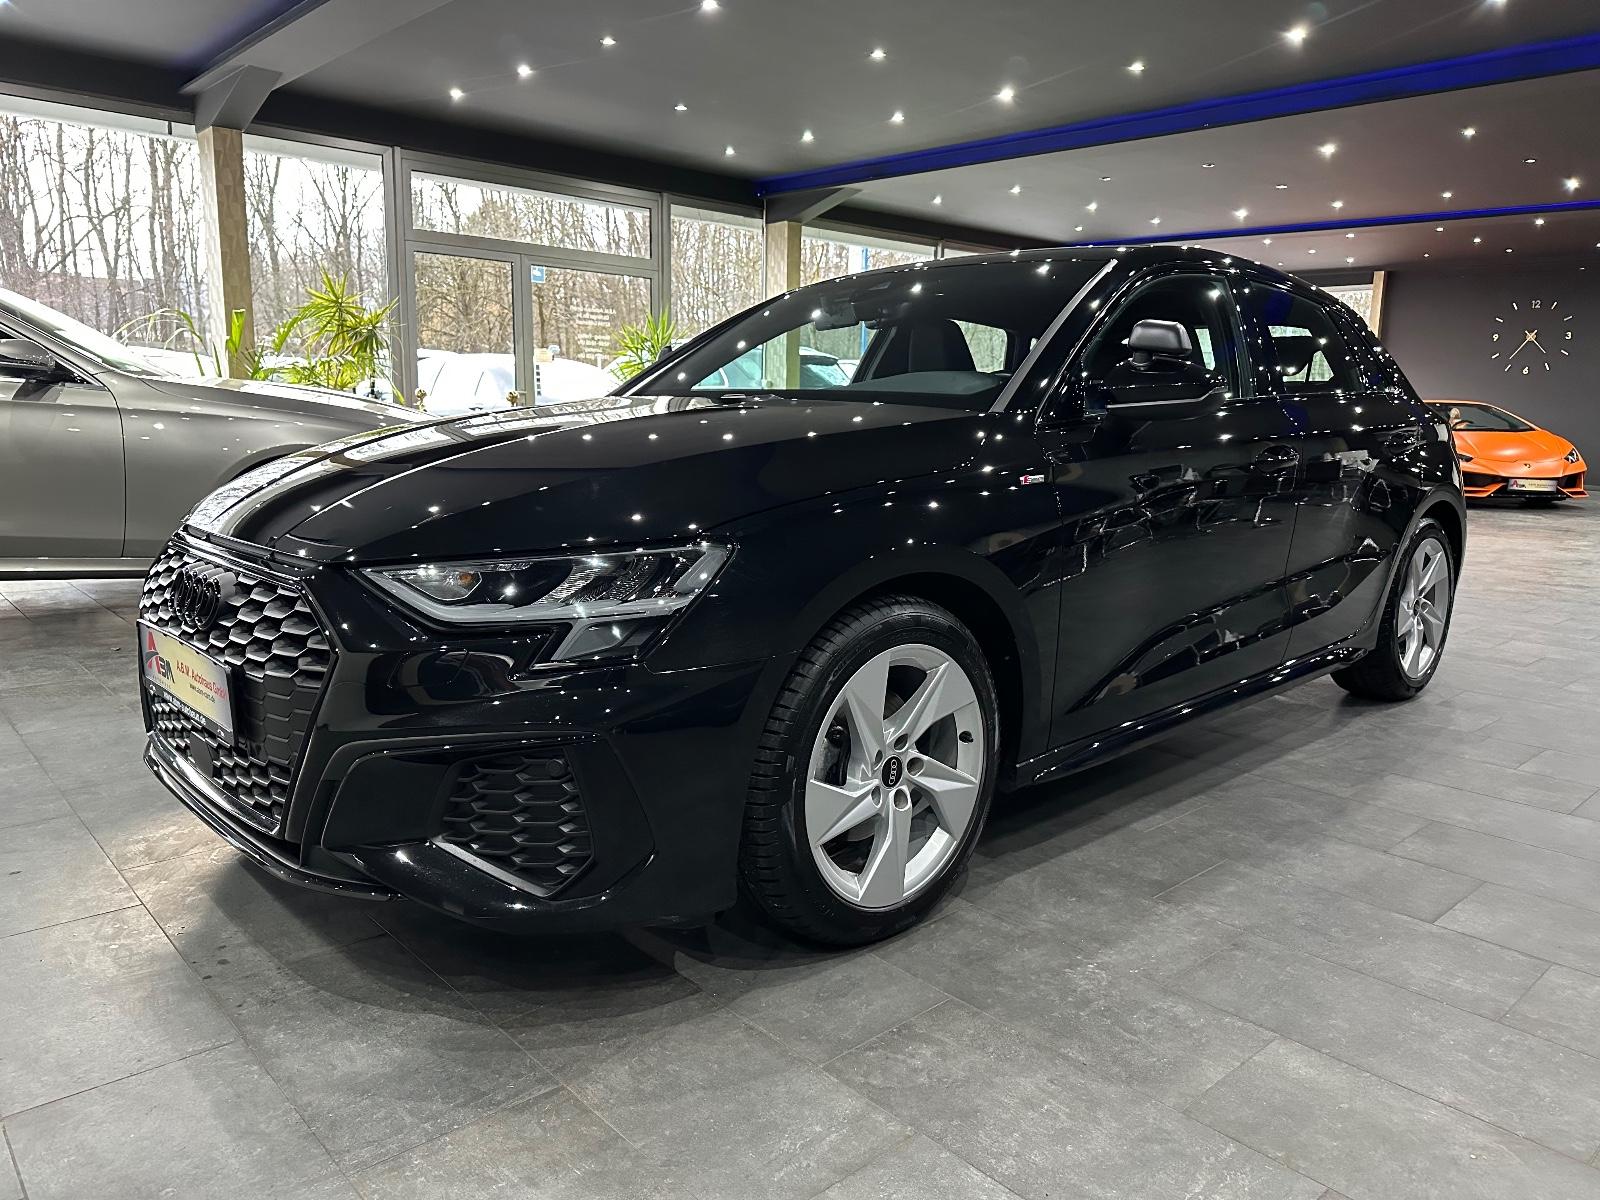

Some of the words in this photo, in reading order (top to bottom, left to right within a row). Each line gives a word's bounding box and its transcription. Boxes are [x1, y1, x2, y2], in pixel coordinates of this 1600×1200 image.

[1531, 300, 1541, 309] 12
[1492, 333, 1499, 342] 9
[1565, 332, 1572, 340] 3
[1522, 366, 1529, 375] 6
